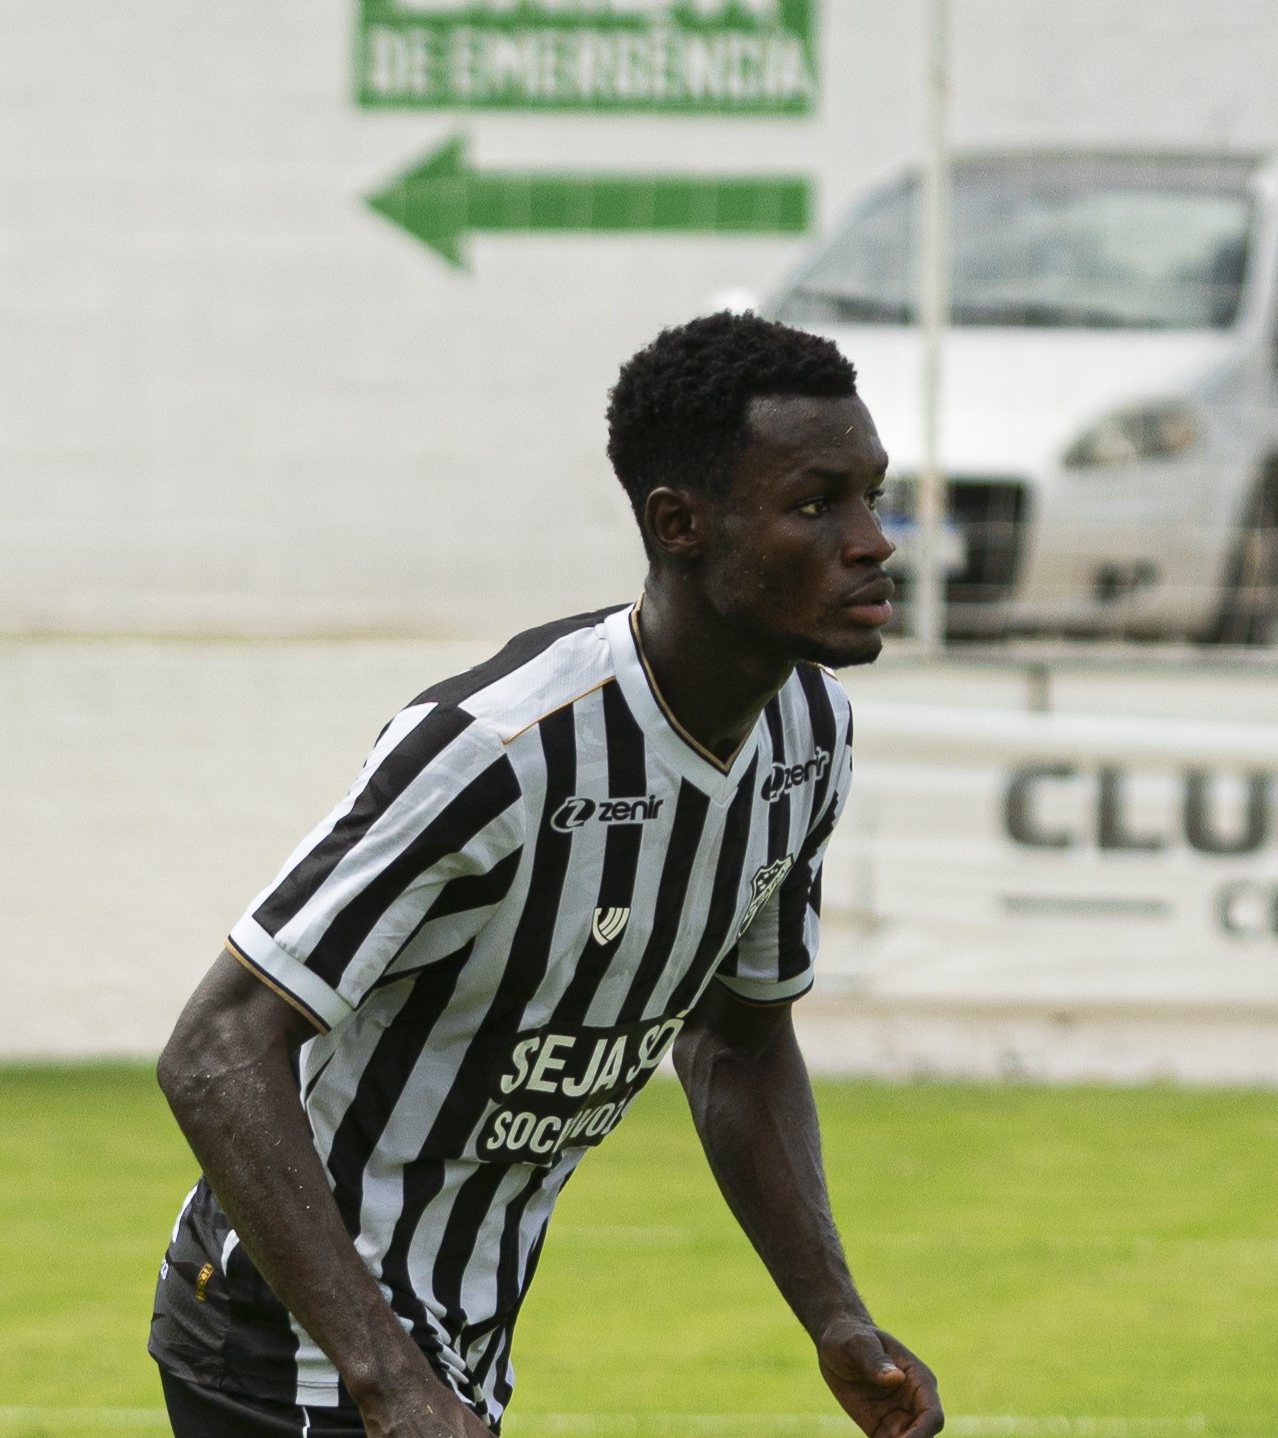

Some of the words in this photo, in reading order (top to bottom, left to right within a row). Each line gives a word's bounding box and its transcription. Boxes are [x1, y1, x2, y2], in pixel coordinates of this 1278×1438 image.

[371, 27, 430, 92] DE
[598, 795, 664, 823] zenir
[500, 1033, 629, 1098] SEJA
